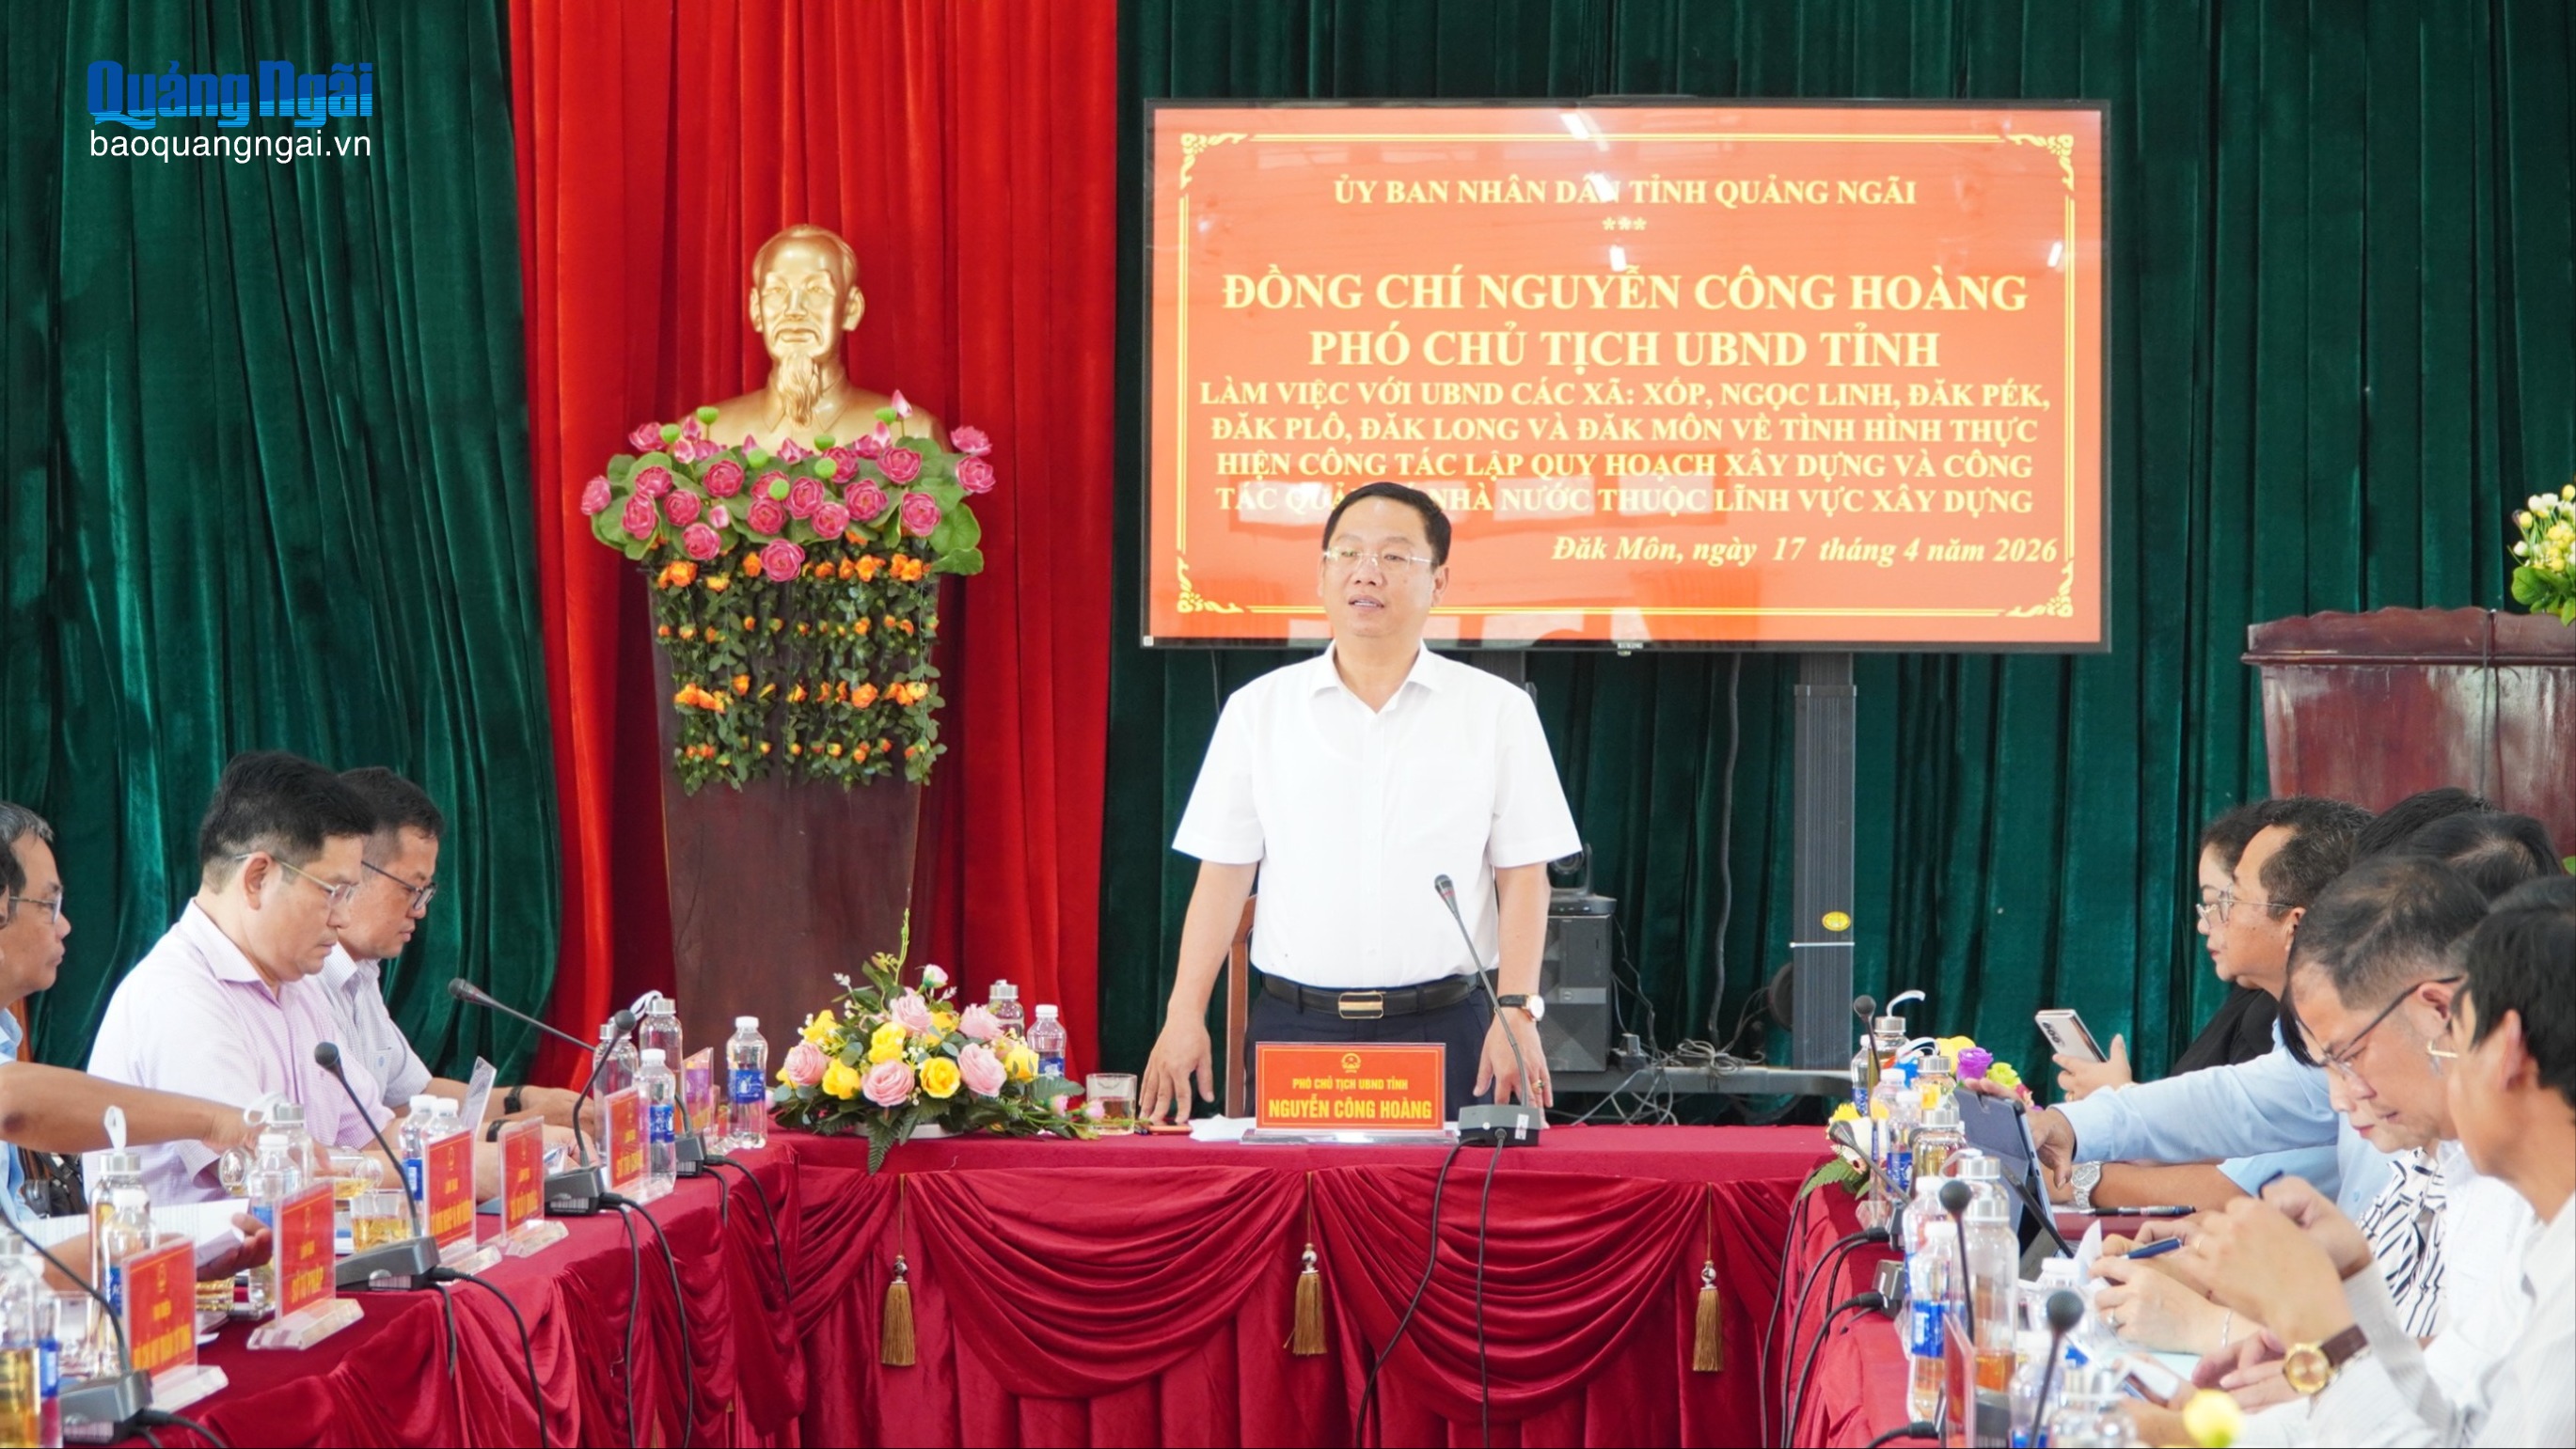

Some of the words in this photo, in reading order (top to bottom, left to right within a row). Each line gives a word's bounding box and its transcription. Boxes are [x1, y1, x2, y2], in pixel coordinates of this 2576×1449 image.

[1335, 173, 1378, 204] ỦY
[1385, 180, 1449, 204] BAN
[1457, 173, 1547, 204] NHÂN
[1627, 173, 1707, 204] TỈNH
[1715, 174, 1828, 209] QUẢNG
[1837, 175, 1916, 204] NGÃI
[1223, 263, 1364, 310] ĐỒNG
[1376, 263, 1464, 309] CHÍ
[1477, 263, 1682, 310] NGUYỄN
[1694, 264, 1837, 310] CÔNG
[1849, 264, 2028, 311] HOÀNG
[1308, 320, 1411, 366] PHÓ
[1422, 320, 1527, 367] CHỦ
[1540, 330, 1661, 376] TỊCH
[1673, 331, 1808, 367] UBND
[1819, 321, 1940, 368] TỈNH
[1200, 375, 1268, 404] LÀM
[1275, 378, 1350, 411] VIỆC
[1356, 375, 1413, 405] VỚI
[1420, 382, 1504, 405] UBND
[1510, 375, 1575, 406] CÁC
[1582, 375, 1635, 405] XÃ:
[1642, 375, 1714, 410] XỐP,
[1720, 382, 1810, 411] NGỌC
[1817, 383, 1902, 411] LINH,
[1907, 378, 1974, 407] ĐĂK
[1982, 377, 2050, 411] PÉK,
[1211, 412, 1278, 440] ĐĂK
[1285, 411, 1352, 445] PLÔ,
[1359, 412, 1426, 441] ĐĂK
[1432, 417, 1520, 441] LONG
[1526, 412, 1570, 441] VÀ
[1576, 412, 1644, 441] ĐĂK
[1651, 412, 1723, 442] MÔN
[1731, 411, 1773, 441] VỀ
[1778, 412, 1856, 442] TÌNH
[1863, 412, 1942, 442] HÌNH
[1949, 416, 2038, 448] THỰC
[1217, 449, 1291, 481] HIỆN
[1298, 446, 1387, 476] CÔNG
[1394, 446, 1457, 476] TÁC
[1464, 449, 1524, 482] LẬP
[1530, 453, 1597, 481] QUY
[1605, 453, 1716, 481] HOẠCH
[1725, 447, 1789, 477] XÂY
[1795, 450, 1886, 482] DỰNG
[1892, 448, 1936, 478] VÀ
[1942, 447, 2032, 478] CÔNG
[1215, 481, 1278, 511] TÁC
[1285, 481, 1349, 516] QUẢ
[1429, 483, 1494, 511] NHÀ
[1499, 481, 1591, 512] NƯỚC
[1597, 485, 1708, 517] THUỘC
[1715, 484, 1790, 512] LĨNH
[1796, 485, 1865, 518] VỰC
[1872, 483, 1936, 512] XÂY
[1943, 486, 2033, 518] DỰNG
[1551, 535, 1608, 560] Đăk
[1614, 535, 1683, 564] Môn,
[1692, 536, 1758, 567] ngày
[1773, 536, 1807, 561] 17
[1819, 536, 1897, 568] tháng
[1903, 537, 1920, 562] 4
[1926, 537, 1985, 562] năm
[1992, 537, 2058, 562] 2026
[1292, 1076, 1312, 1090] PHÓ
[1314, 1075, 1334, 1090] CHỦ
[1335, 1078, 1356, 1092] TỊCH
[1358, 1078, 1384, 1090] UBND
[1386, 1076, 1409, 1091] TỈNH
[1268, 1093, 1330, 1119] NGUYỄN
[1334, 1096, 1376, 1119] CÔNG
[1380, 1096, 1432, 1120] HOÀNG
